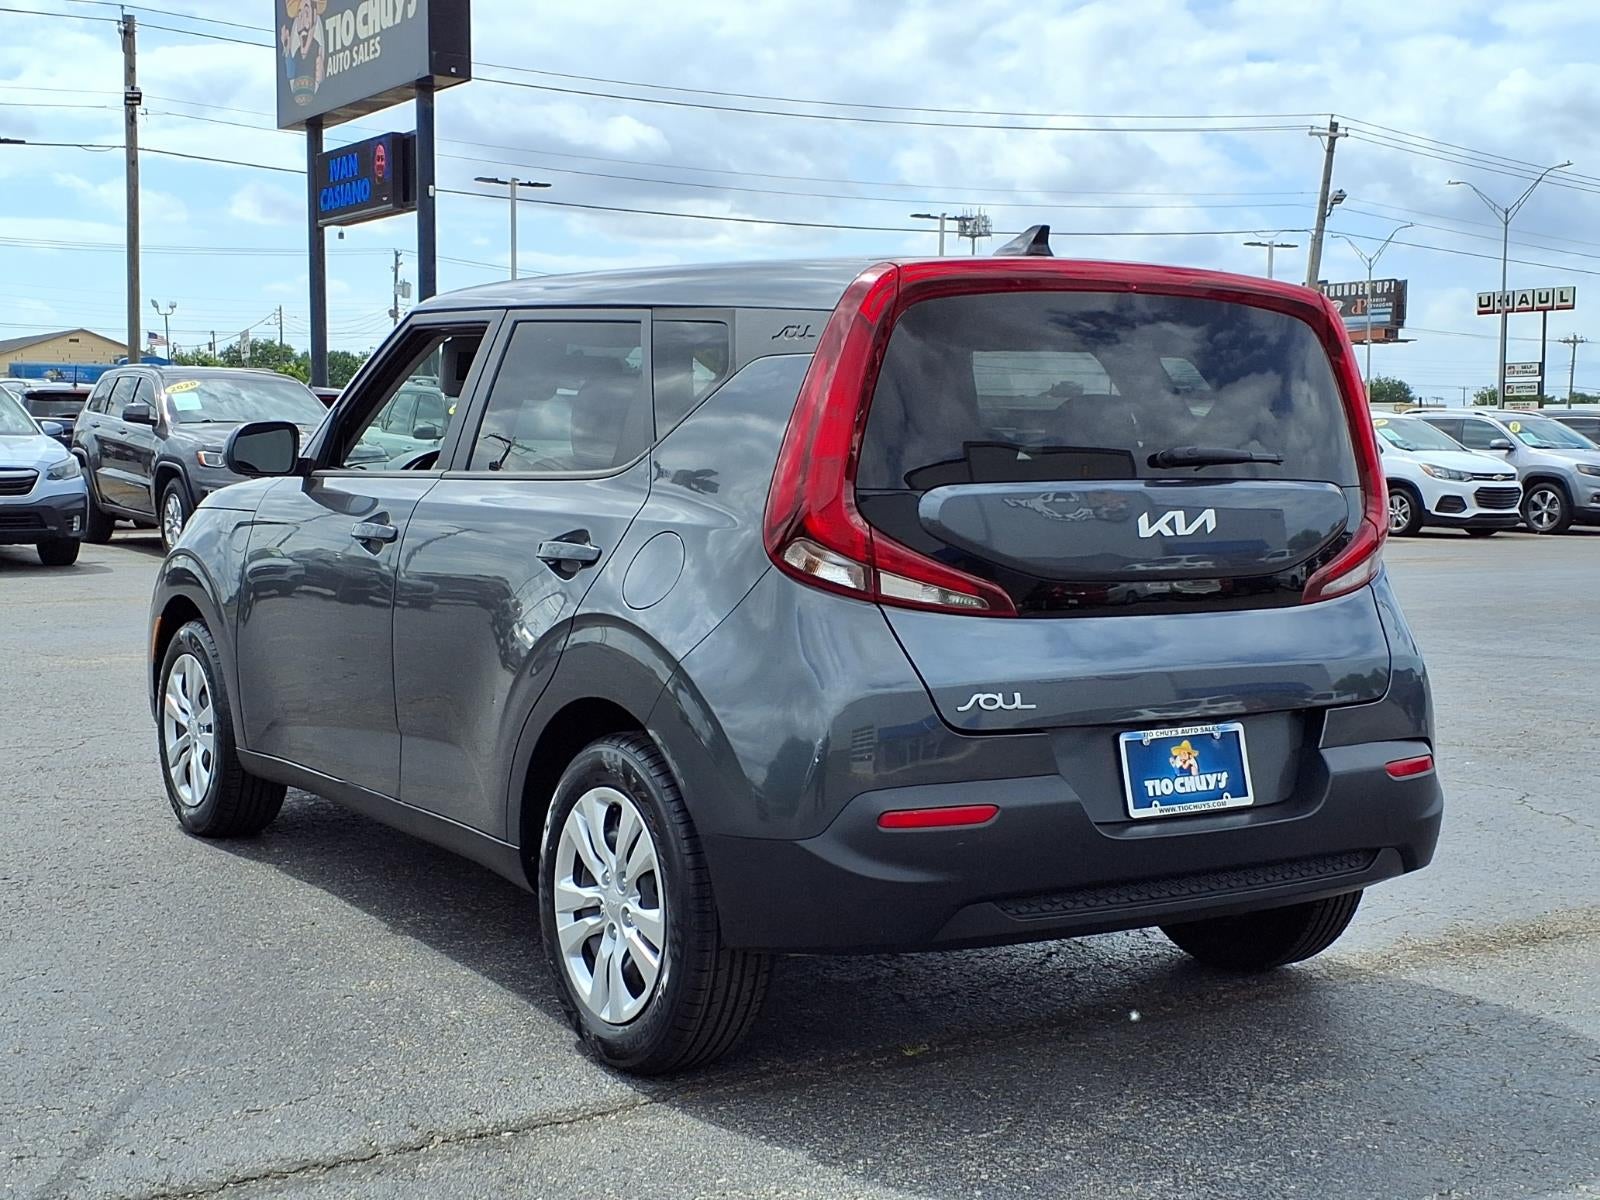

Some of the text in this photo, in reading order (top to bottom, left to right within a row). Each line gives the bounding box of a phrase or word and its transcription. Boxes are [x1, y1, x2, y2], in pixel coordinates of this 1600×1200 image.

[325, 0, 417, 53] TIO CHUY
[326, 36, 381, 77] AUTO SALES
[1376, 281, 1395, 294] UP!
[170, 381, 197, 392] 2020
[957, 692, 1037, 712] SOUL
[1155, 728, 1179, 737] CHUY'S
[1180, 727, 1199, 735] AUTO
[1200, 725, 1221, 733] SALES
[1144, 771, 1229, 797] TIO CHUY'S
[1158, 800, 1227, 814] WWW.TIOCHUYS.COM
